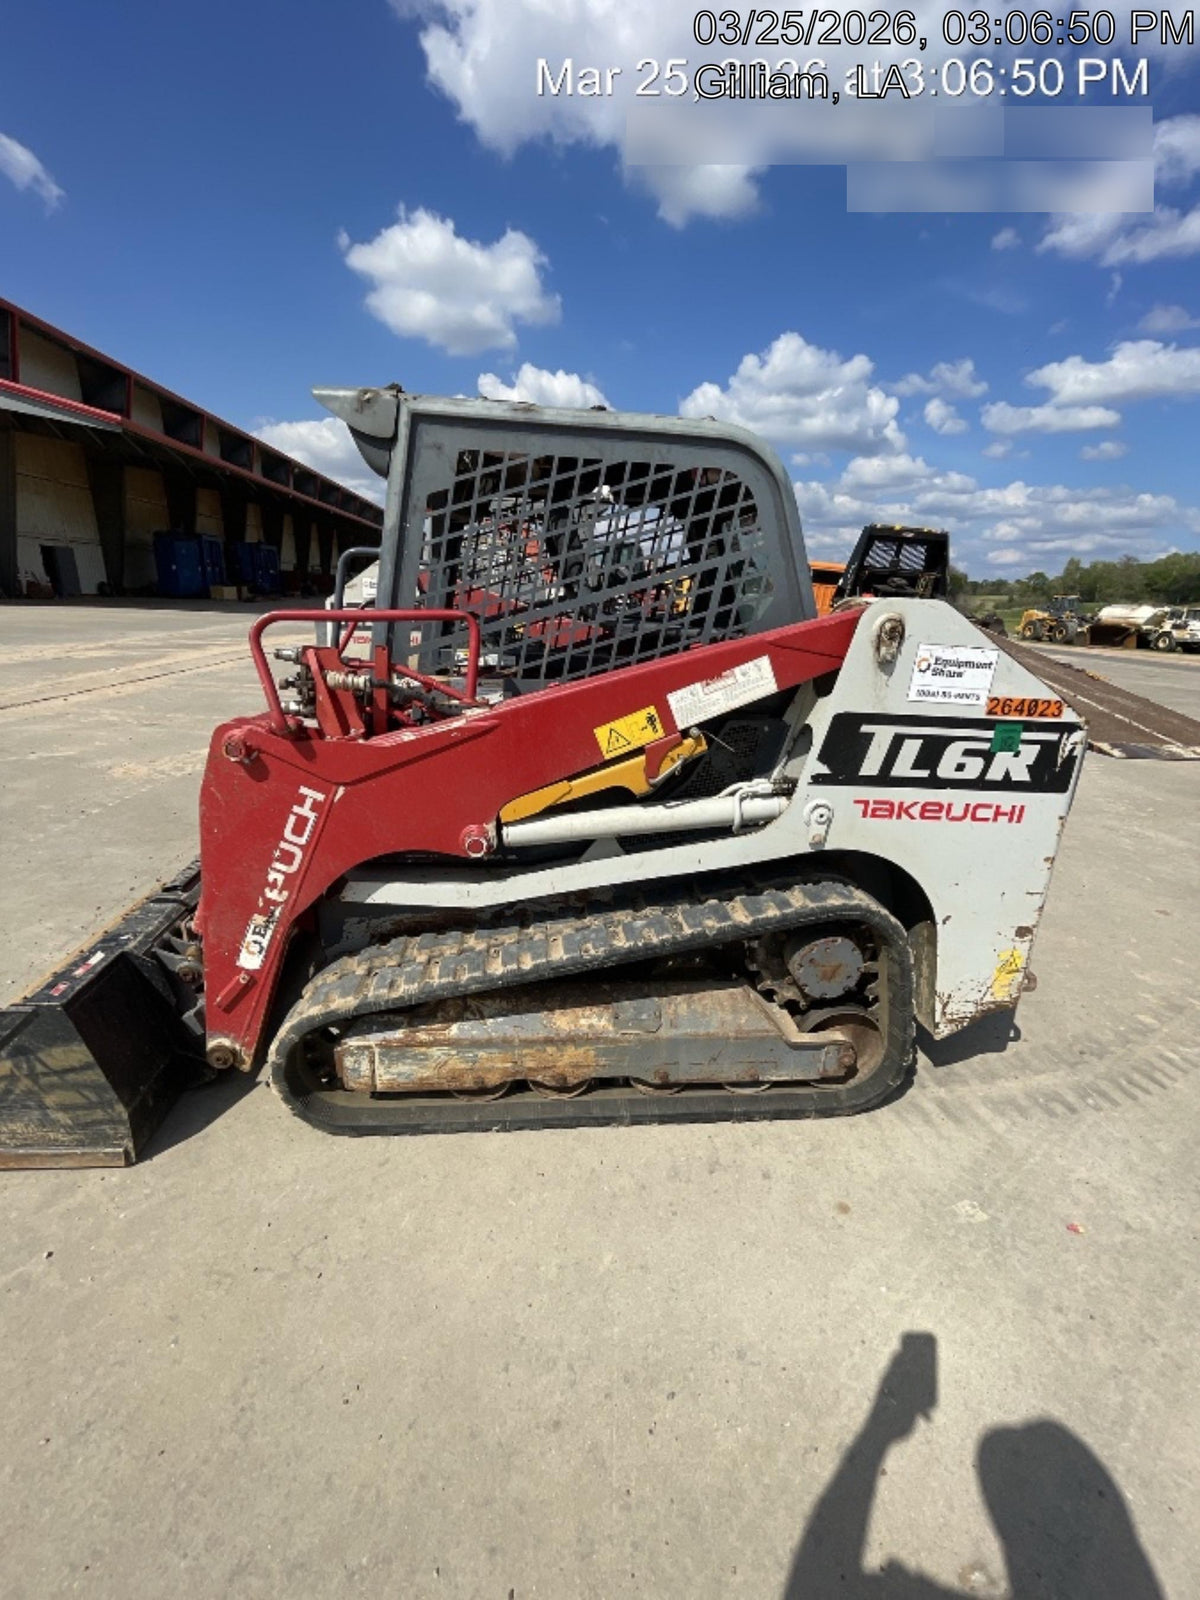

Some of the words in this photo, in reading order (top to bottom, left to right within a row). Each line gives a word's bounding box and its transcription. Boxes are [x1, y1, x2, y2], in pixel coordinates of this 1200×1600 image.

[933, 656, 993, 669] Equipment
[987, 696, 1064, 717] 264023
[858, 724, 1060, 781] TL6R
[853, 799, 1026, 824] TAKEUCHI
